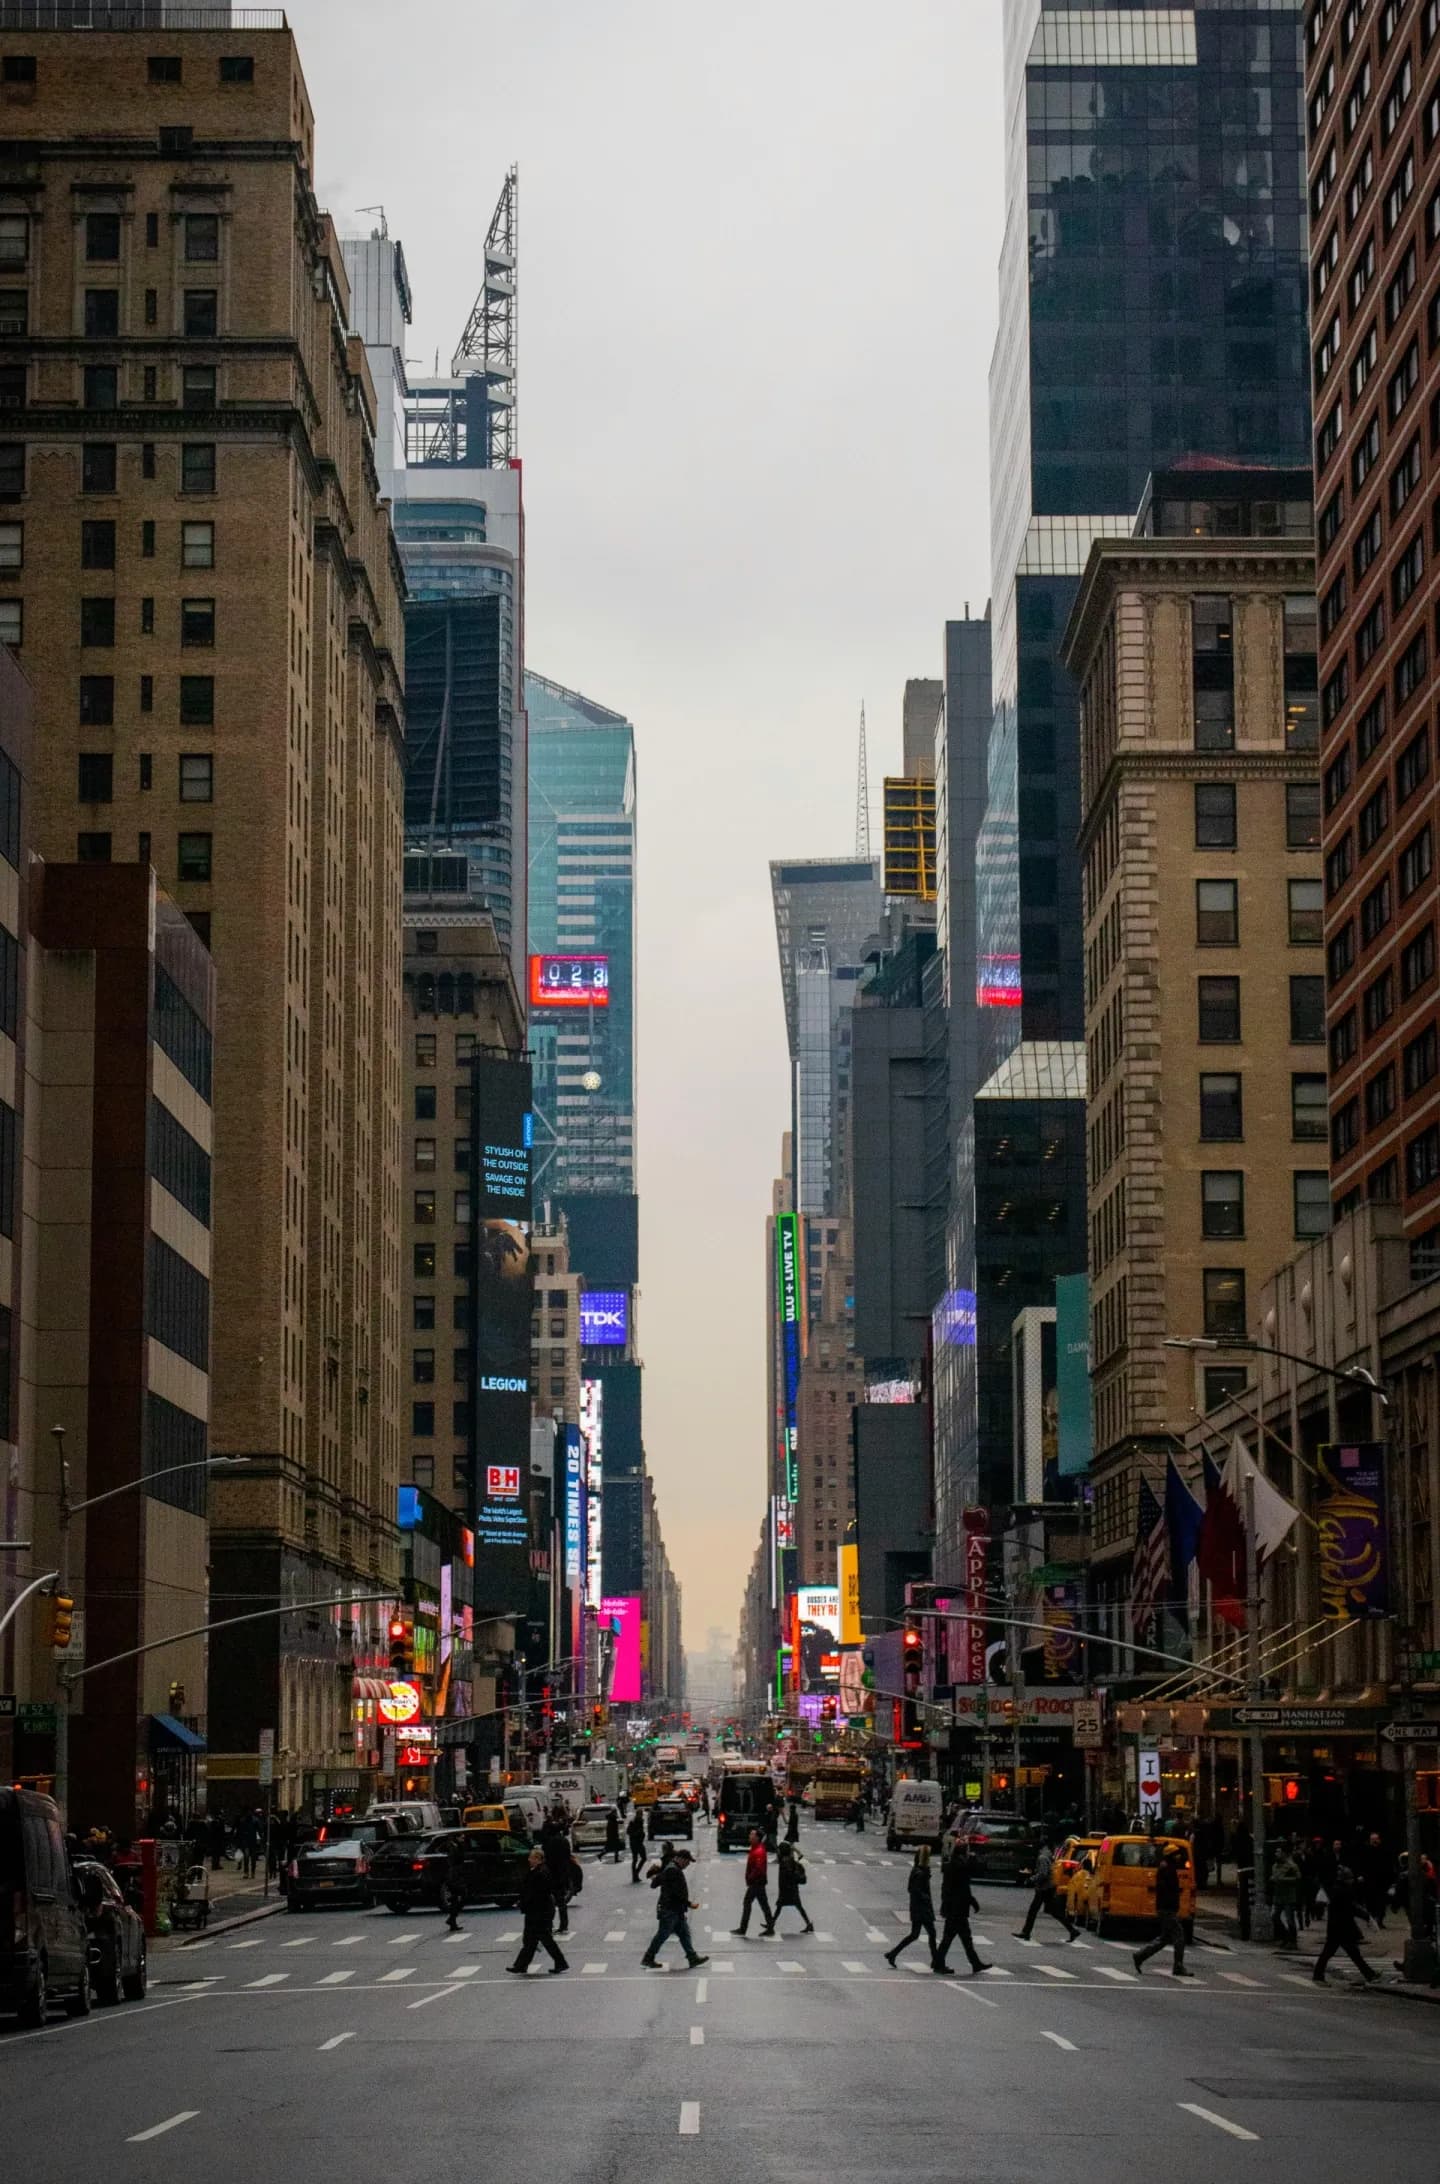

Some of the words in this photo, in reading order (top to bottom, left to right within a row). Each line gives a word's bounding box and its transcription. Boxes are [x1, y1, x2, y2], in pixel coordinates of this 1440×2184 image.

[485, 1146, 513, 1157] STYLISH
[514, 1149, 527, 1158] ON
[483, 1158, 497, 1168] THE
[498, 1160, 529, 1171] OUTSIDE
[485, 1172, 513, 1184] SAVAGE
[514, 1176, 527, 1185] ON
[487, 1185, 501, 1194] THE
[502, 1187, 526, 1197] INSIDE
[783, 1230, 793, 1249] TV
[784, 1251, 794, 1281] LIVE
[580, 1311, 622, 1326] TDK
[481, 1376, 527, 1392] LEGION
[567, 1445, 579, 1473] 20
[567, 1479, 580, 1541] TIMES
[1077, 1719, 1098, 1732] 25
[1388, 1727, 1408, 1737] ONE
[1413, 1727, 1433, 1736] WAY
[1145, 1760, 1155, 1776] I
